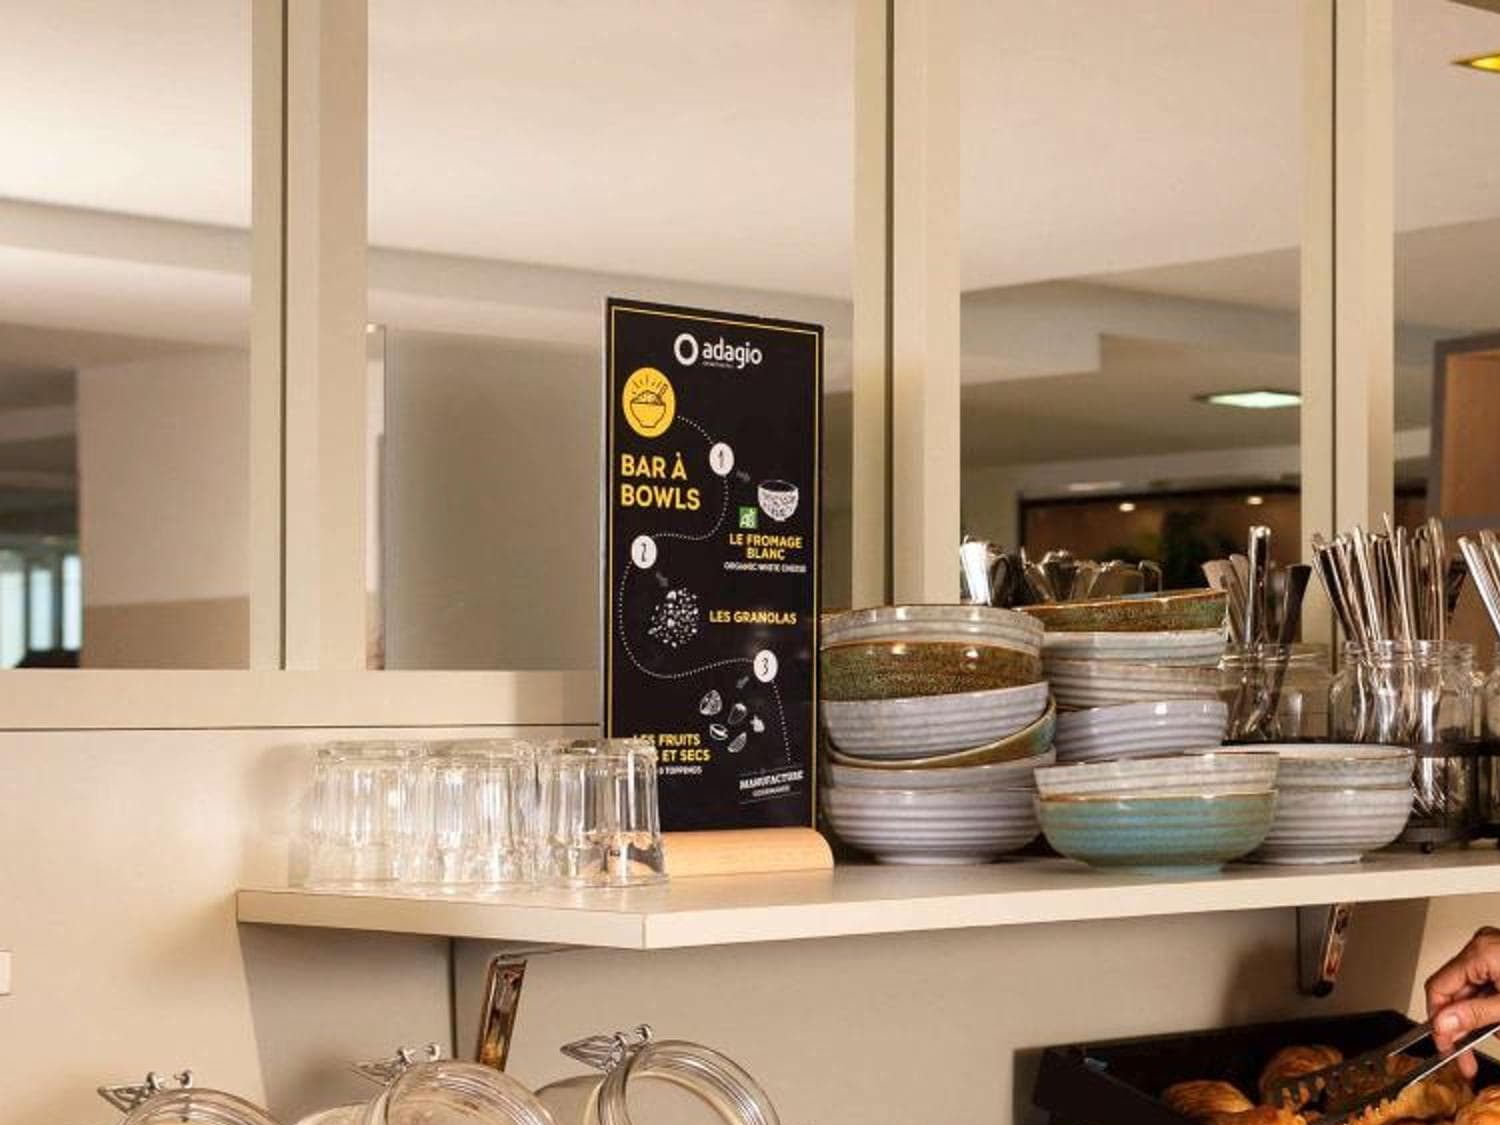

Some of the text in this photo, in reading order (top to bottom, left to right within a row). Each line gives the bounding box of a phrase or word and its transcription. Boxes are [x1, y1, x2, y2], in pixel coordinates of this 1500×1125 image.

[702, 337, 763, 369] adagio
[621, 452, 688, 480] BAR À
[621, 485, 701, 511] BOWLS
[729, 533, 803, 549] LE FROMAGE
[746, 548, 785, 561] BLANC
[709, 609, 797, 625] LES GRANOLAS
[659, 734, 701, 746] FRUITS
[662, 749, 677, 762] ET
[679, 750, 711, 762] SECS
